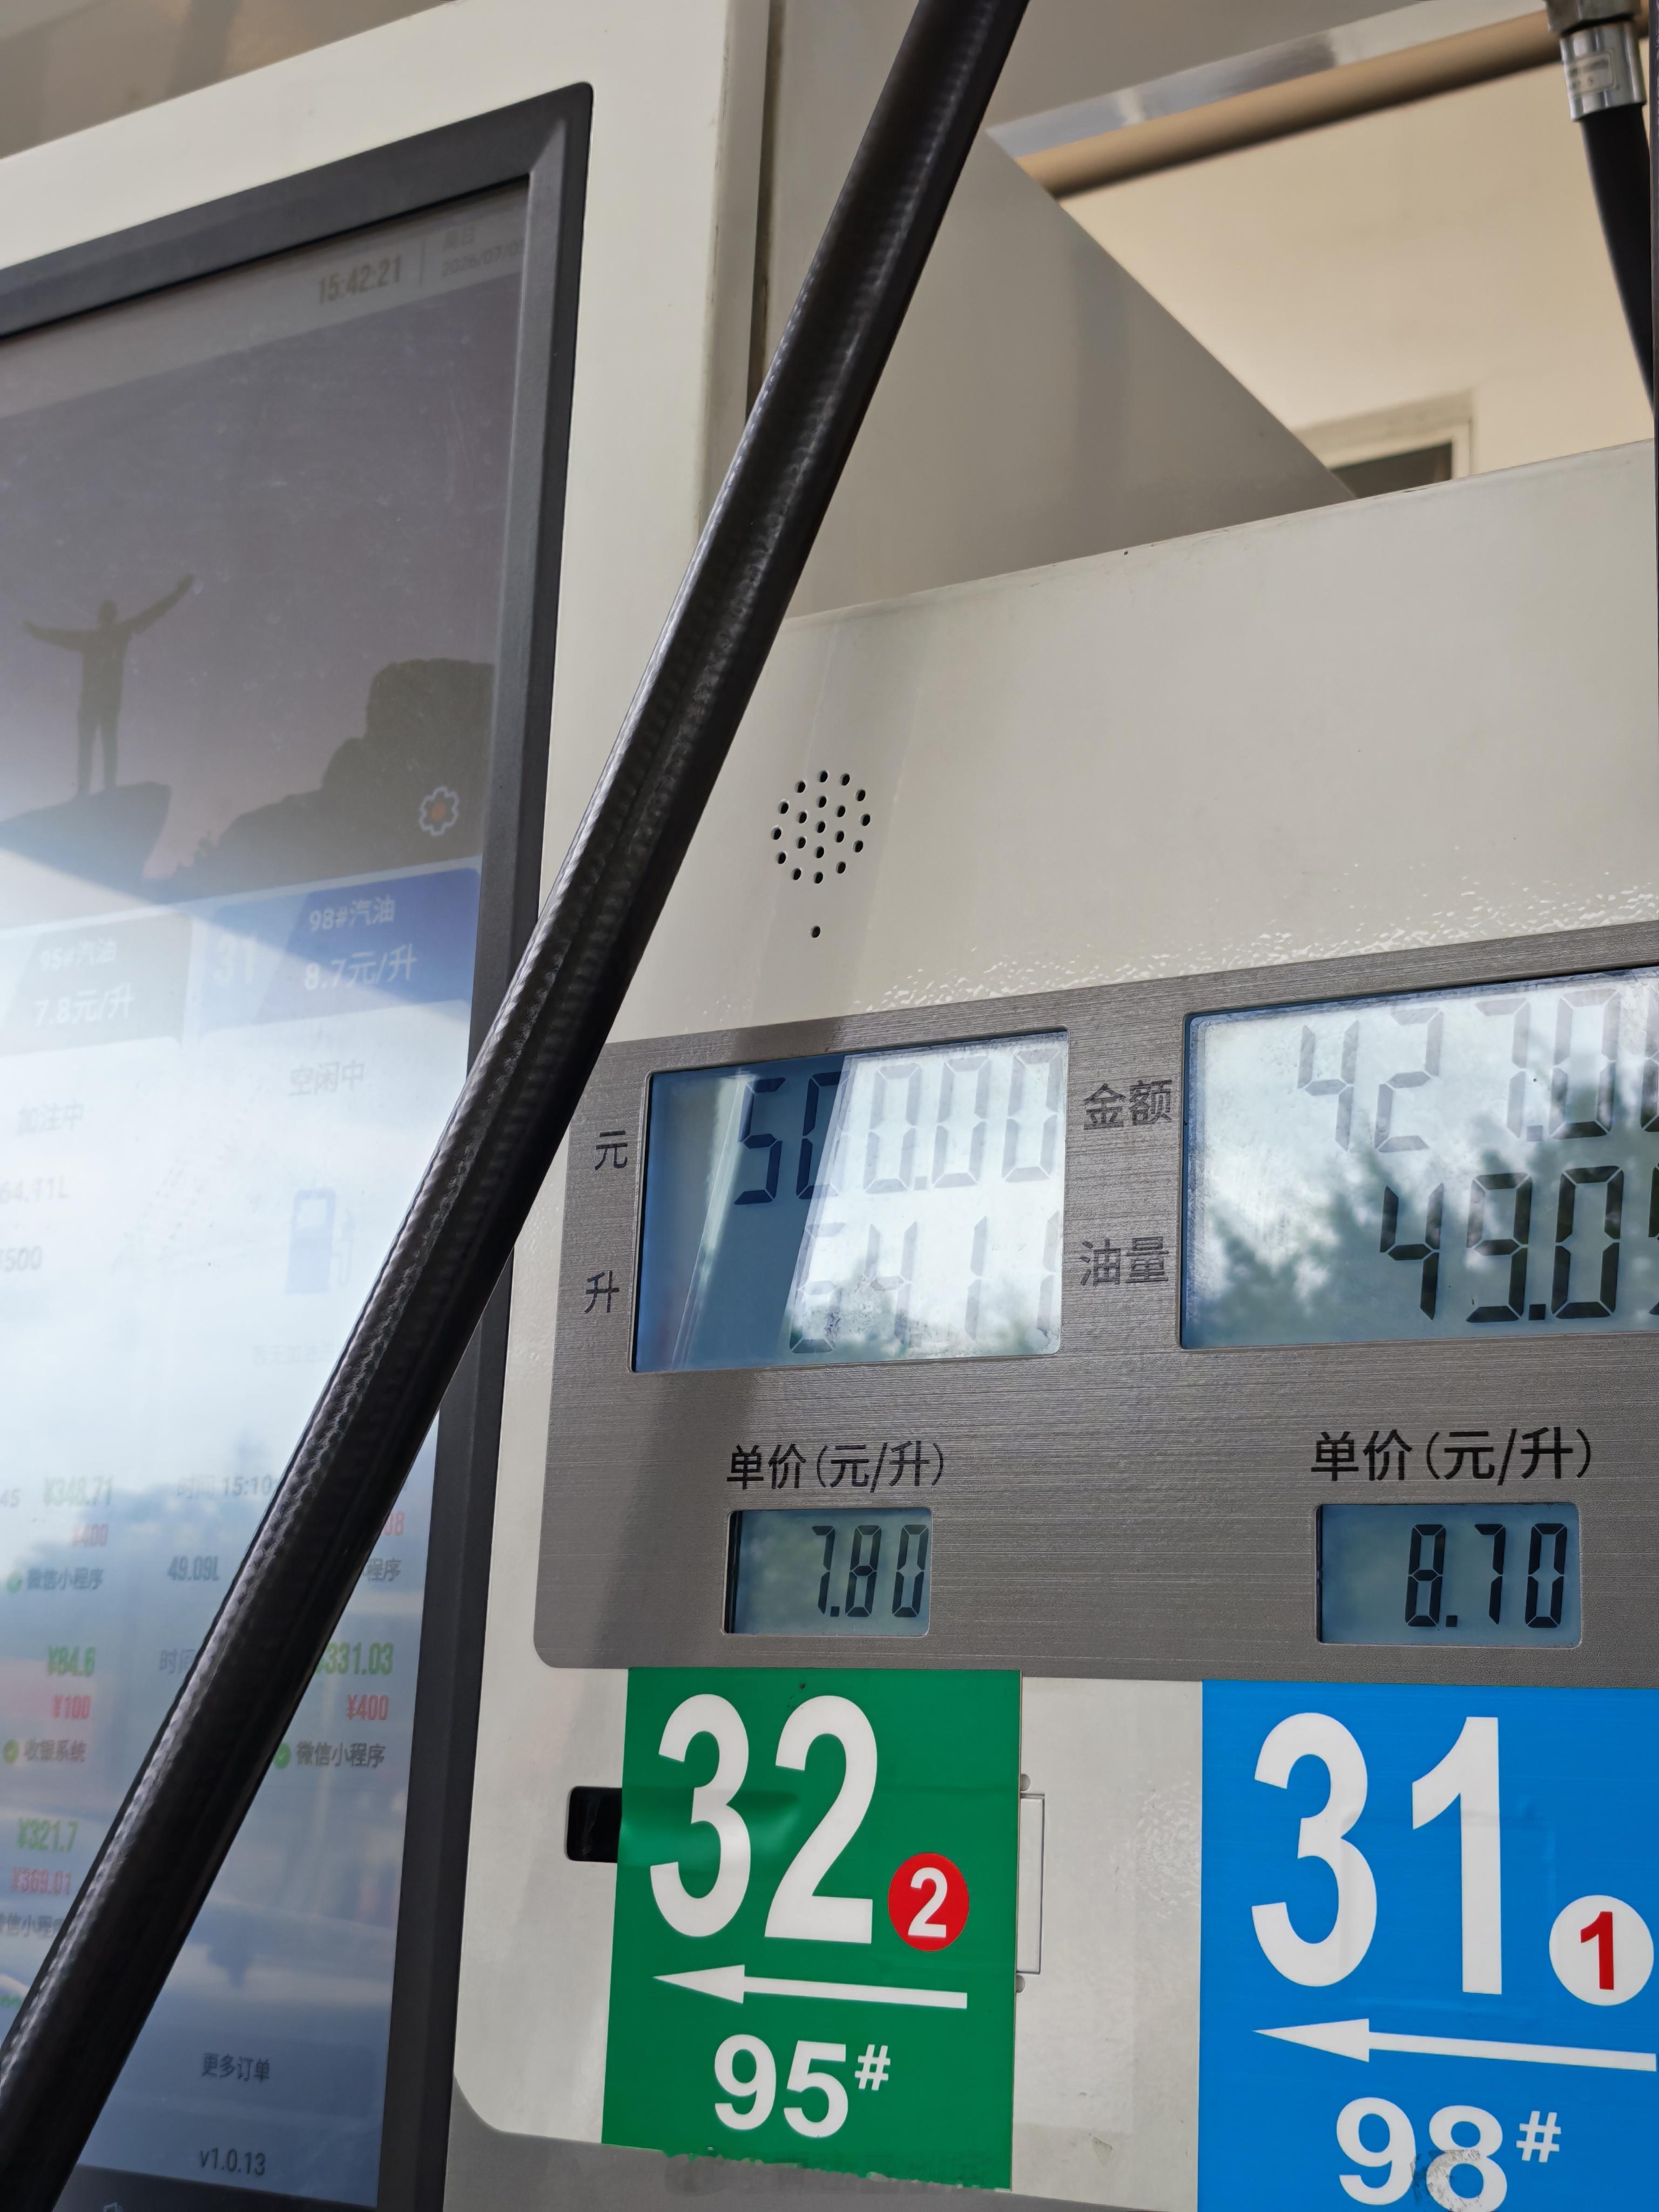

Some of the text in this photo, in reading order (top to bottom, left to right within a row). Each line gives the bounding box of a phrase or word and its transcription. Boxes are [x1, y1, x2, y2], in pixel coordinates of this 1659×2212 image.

[319, 254, 401, 305] 15:42:21
[308, 895, 395, 932] 98#汽油
[214, 934, 257, 984] 31
[305, 943, 417, 990] 8.7元/升
[35, 982, 134, 1027] 7.8元/升
[288, 1060, 366, 1097] 空闲中
[734, 1050, 1064, 1204] 500.00
[1082, 1079, 1173, 1131] 金额
[595, 1130, 628, 1171] 元
[1080, 1236, 1169, 1287] 油量
[1380, 1164, 1659, 1323] 49.0
[584, 1270, 619, 1313] 升
[726, 1440, 943, 1493] 单价(元/升)
[1311, 1426, 1591, 1486] 单价(元/升)
[177, 1474, 215, 1499] 时间
[812, 1525, 929, 1618] 7.80
[1404, 1523, 1567, 1628] 8.70
[53, 1694, 91, 1720] ¥100
[346, 1694, 389, 1721] ¥400
[296, 1741, 387, 1769] 微信小程序
[650, 1694, 878, 1944] 32
[1252, 1712, 1502, 1995] 31
[908, 1867, 948, 1938] 2
[1580, 1911, 1615, 1990] 1
[200, 2053, 270, 2082] 更多订单
[713, 2034, 891, 2138] 95#
[199, 2147, 267, 2176] v1.0.13
[1336, 2096, 1562, 2212] 98#
